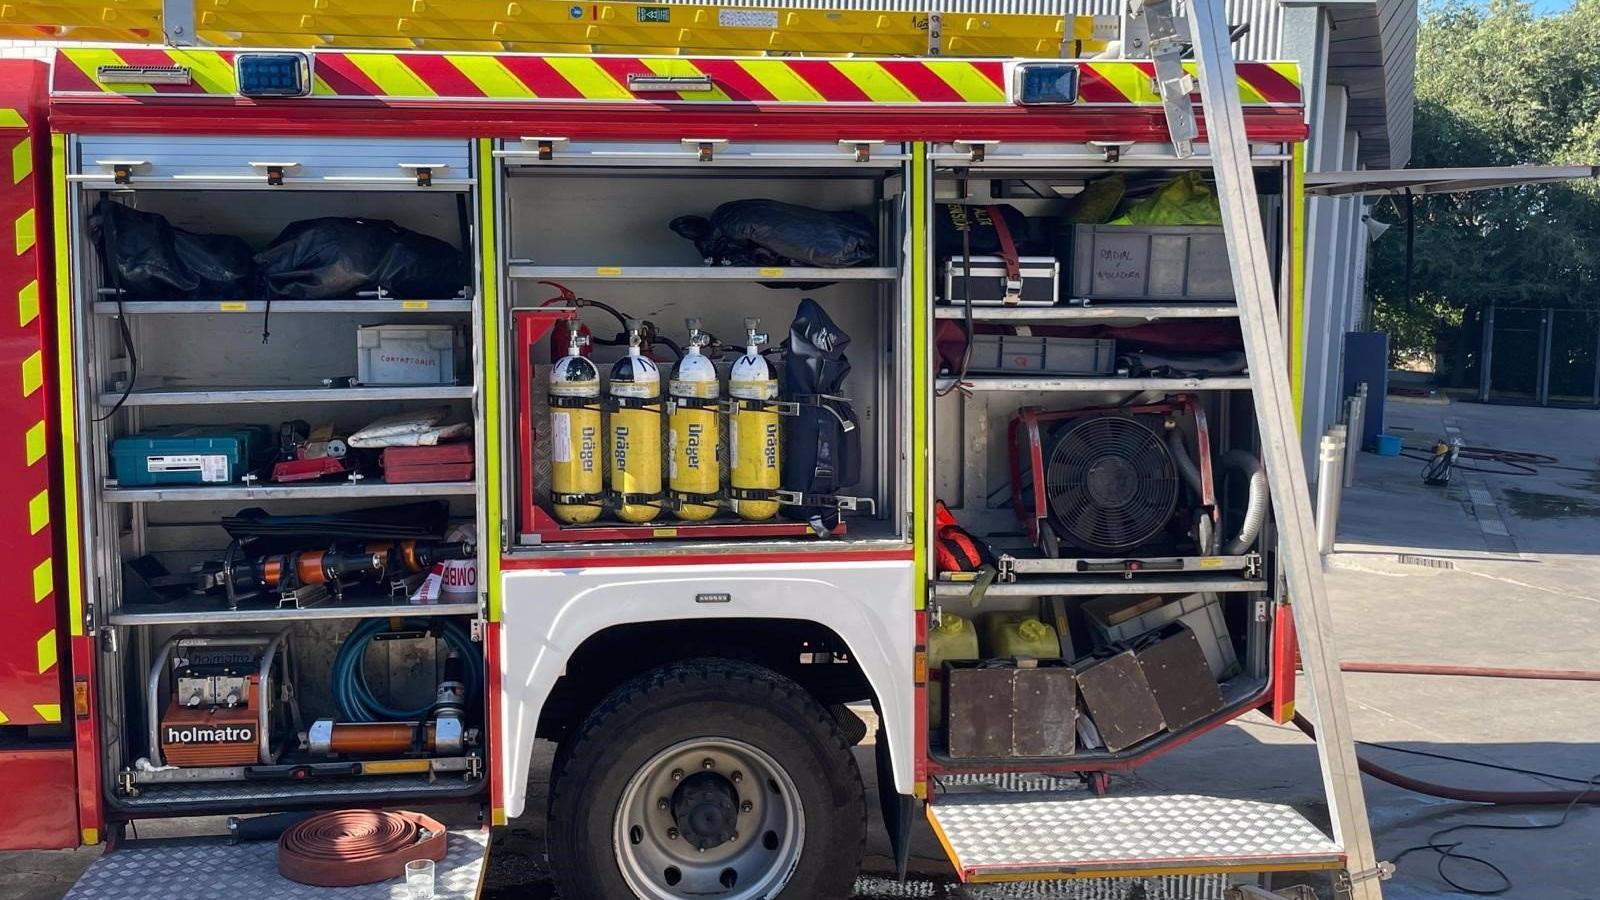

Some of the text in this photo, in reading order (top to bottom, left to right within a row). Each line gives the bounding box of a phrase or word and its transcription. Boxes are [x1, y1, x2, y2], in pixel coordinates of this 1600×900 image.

[580, 426, 596, 473] Dräger
[615, 426, 629, 473] Dräger
[686, 423, 704, 470] Dräger
[765, 423, 778, 469] Dräger
[168, 727, 252, 743] holmatro
